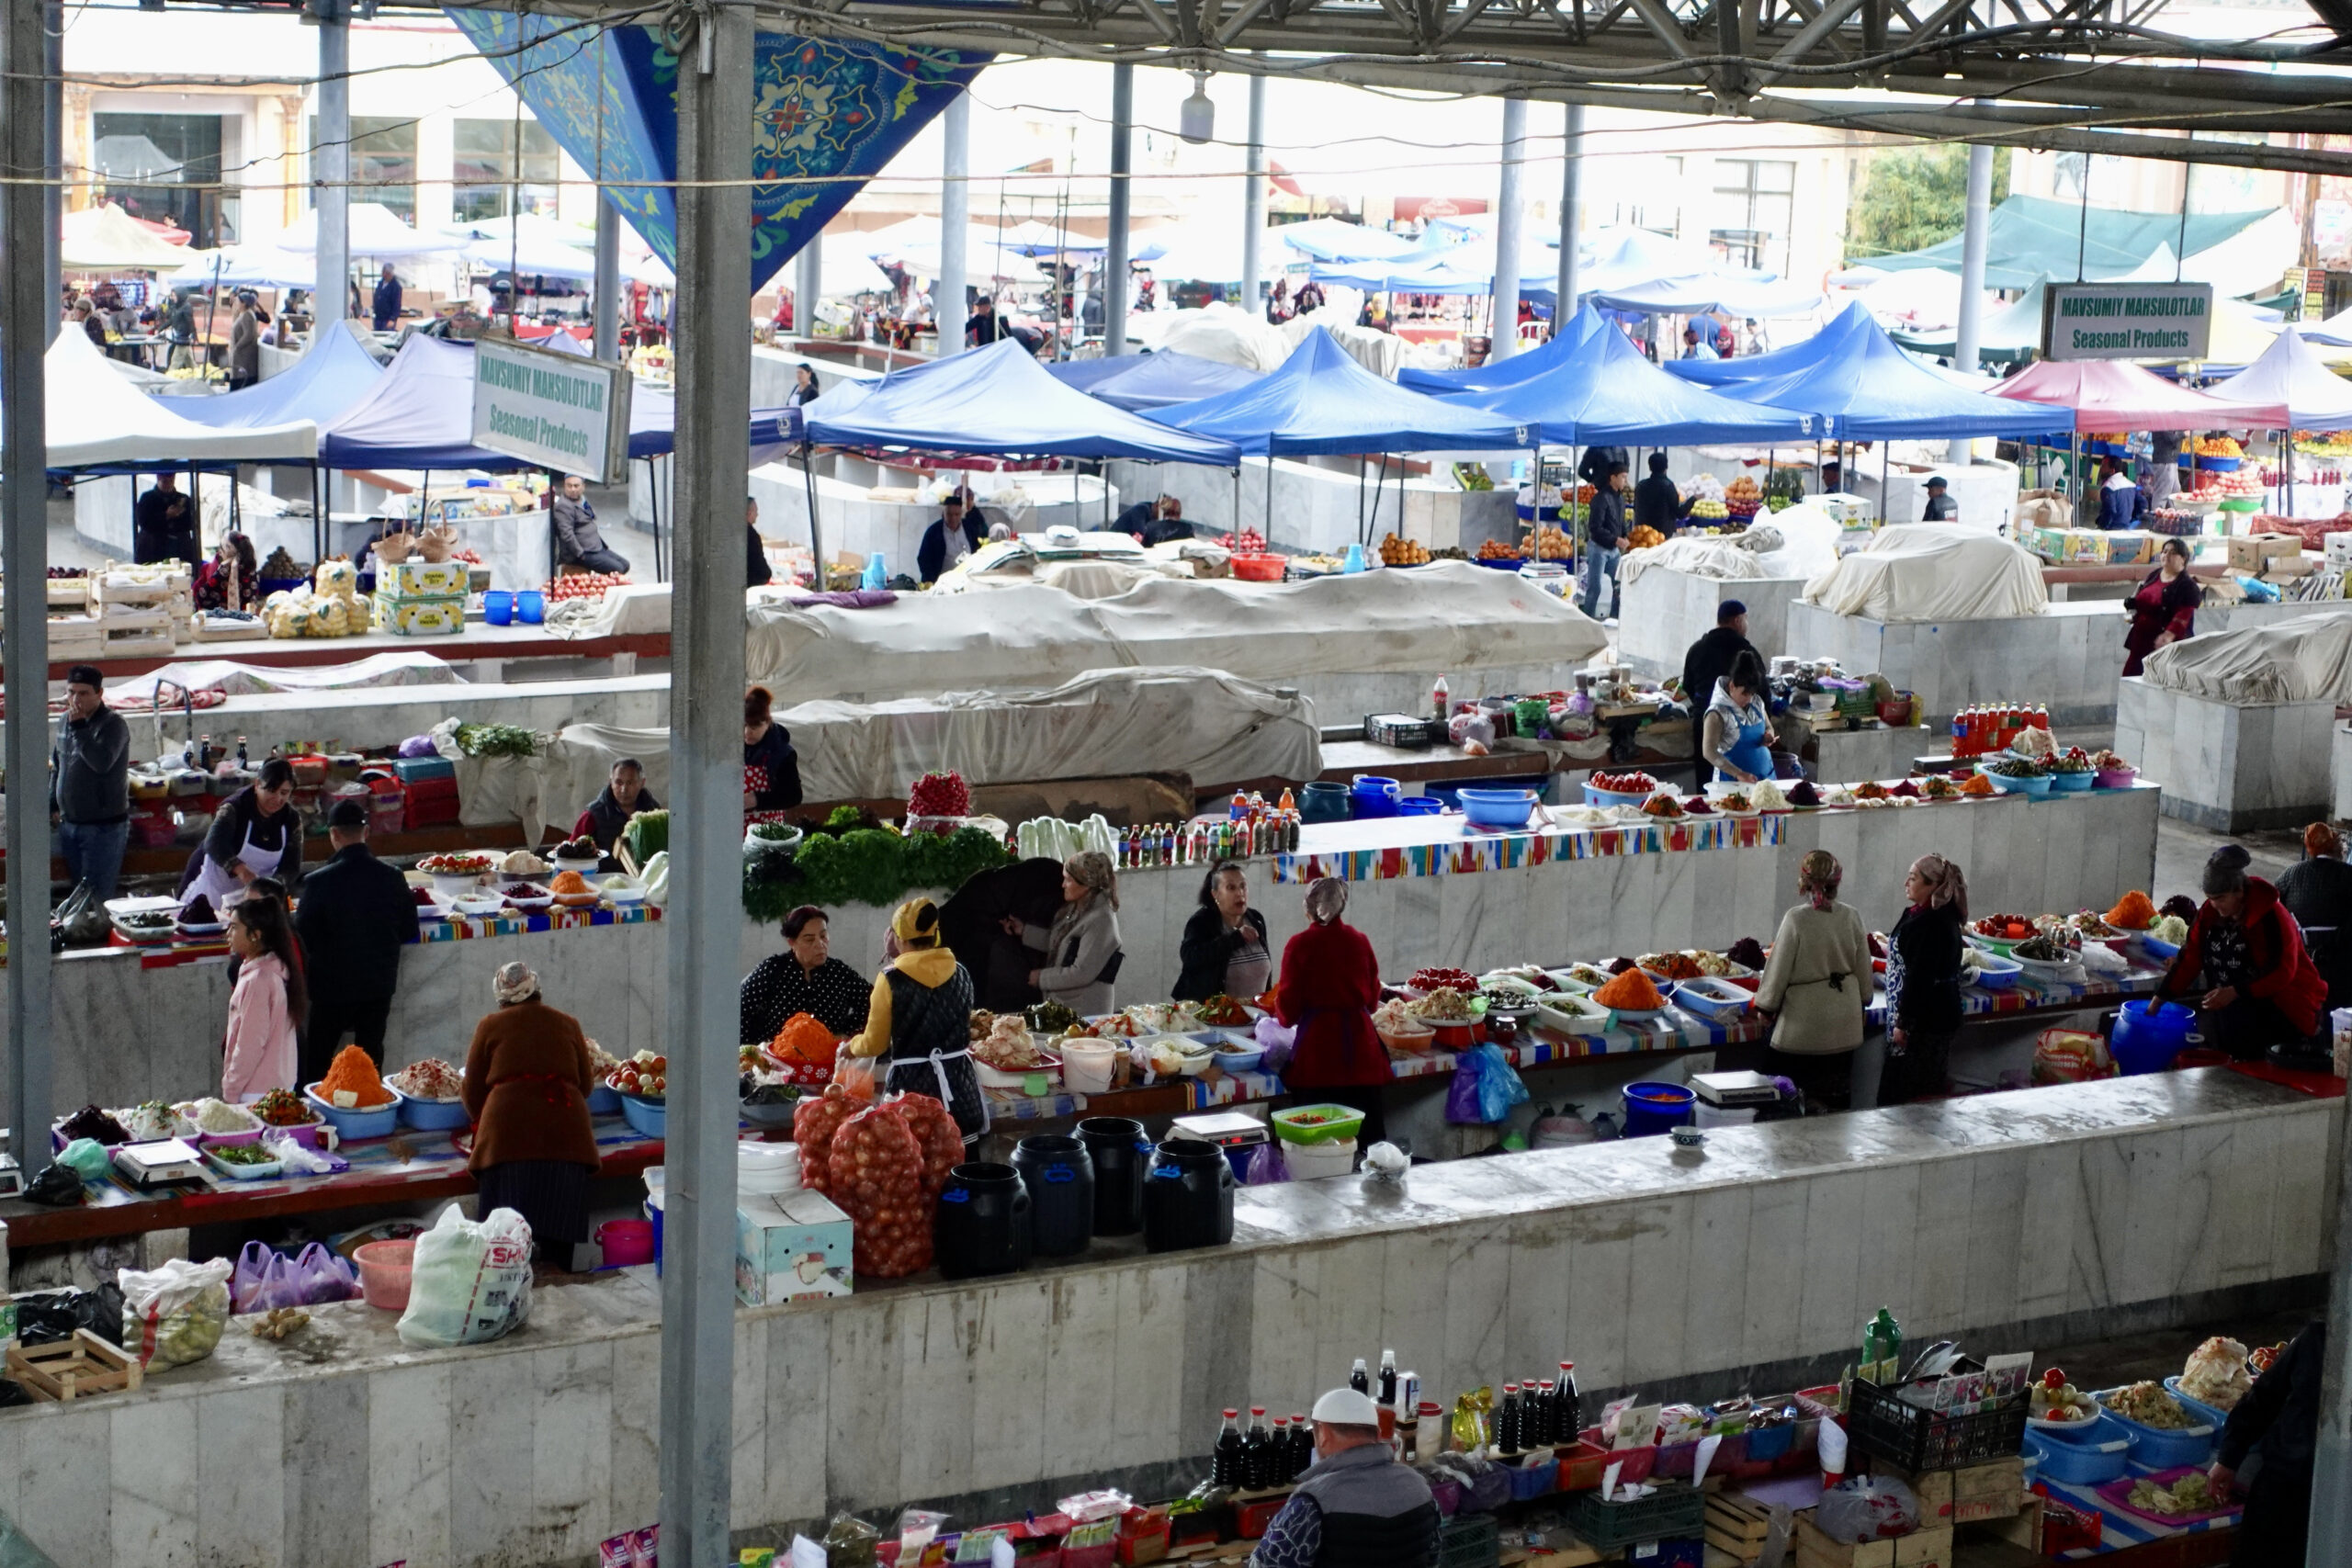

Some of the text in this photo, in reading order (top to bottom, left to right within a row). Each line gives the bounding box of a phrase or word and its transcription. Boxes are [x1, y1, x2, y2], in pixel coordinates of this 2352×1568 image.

[2061, 296, 2205, 317] MAVSUMIY MAHSULOTLAR
[2073, 328, 2189, 349] Seasonal Products
[480, 355, 604, 412] MAVSUMIY MAHSULOTLAR
[490, 403, 588, 457] Seasonal Products
